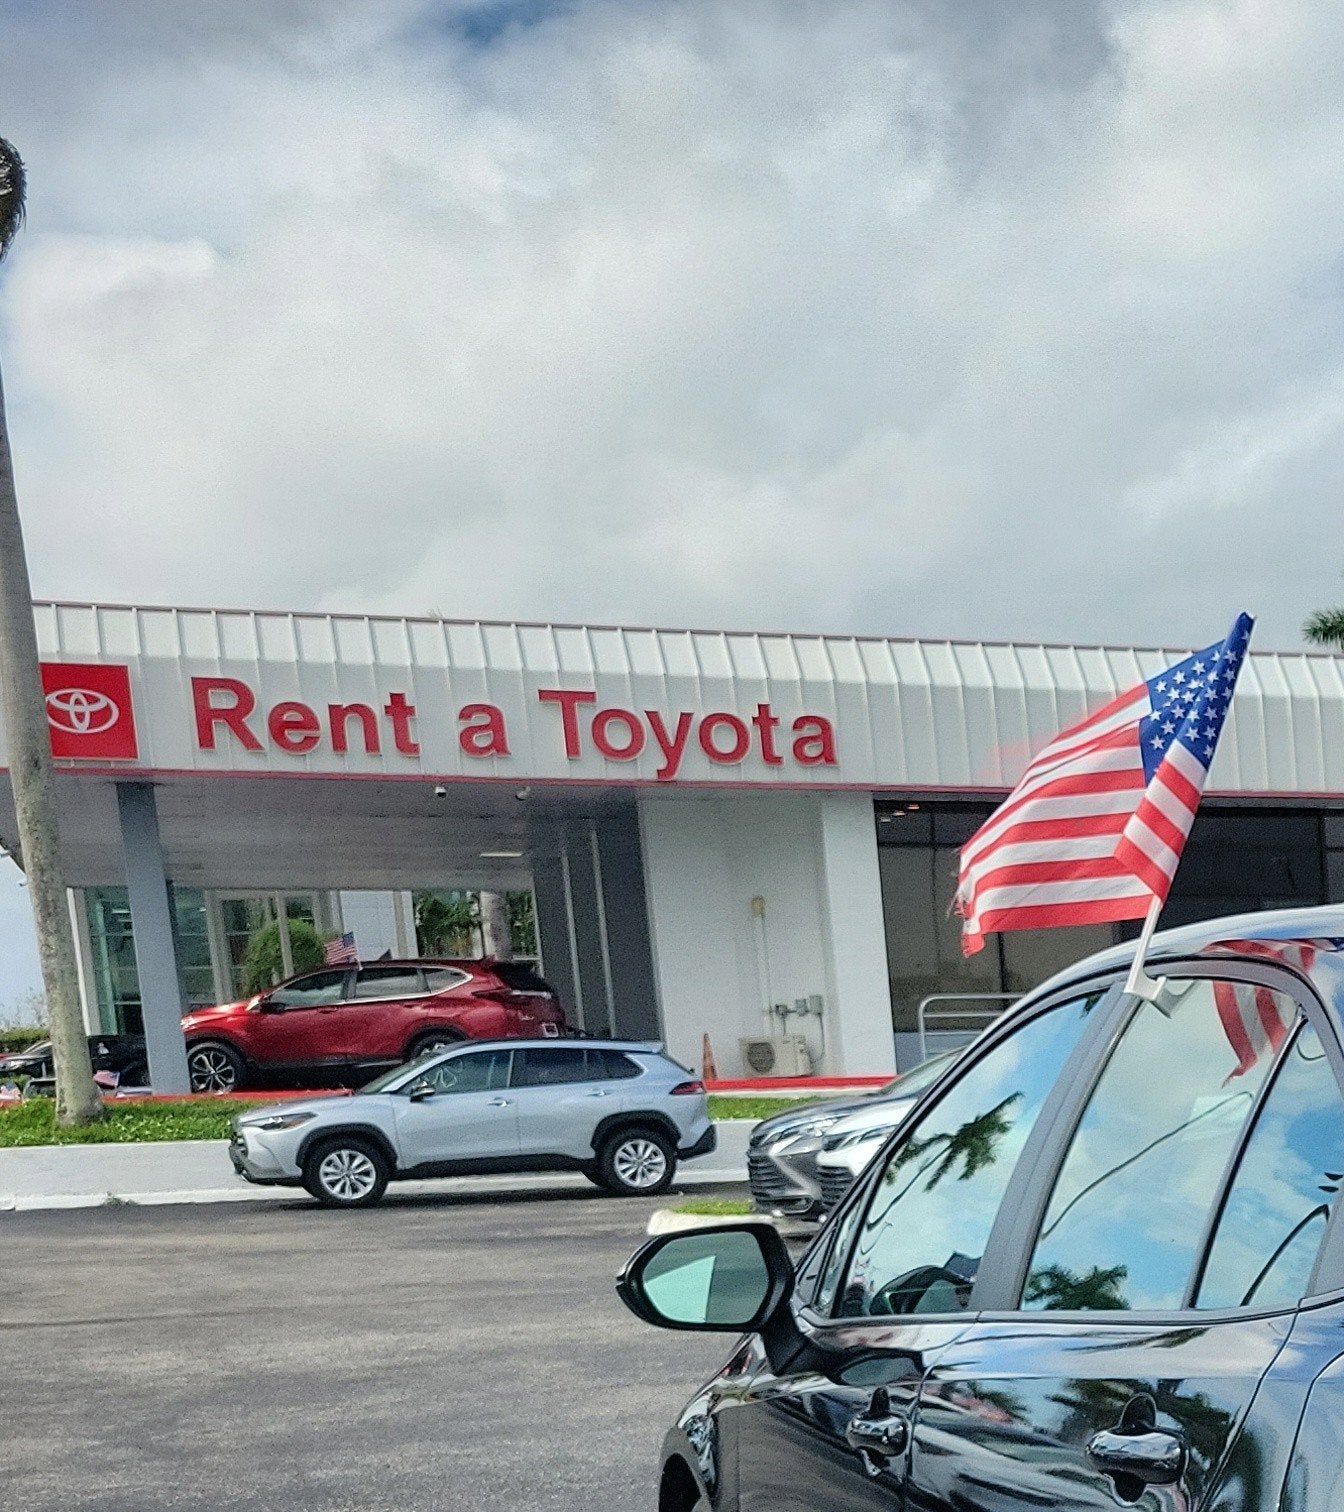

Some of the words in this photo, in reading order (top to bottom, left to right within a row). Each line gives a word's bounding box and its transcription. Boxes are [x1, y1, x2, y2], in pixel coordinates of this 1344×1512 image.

[191, 676, 421, 757] Rent
[458, 702, 513, 758] a
[537, 688, 839, 780] Toyota
